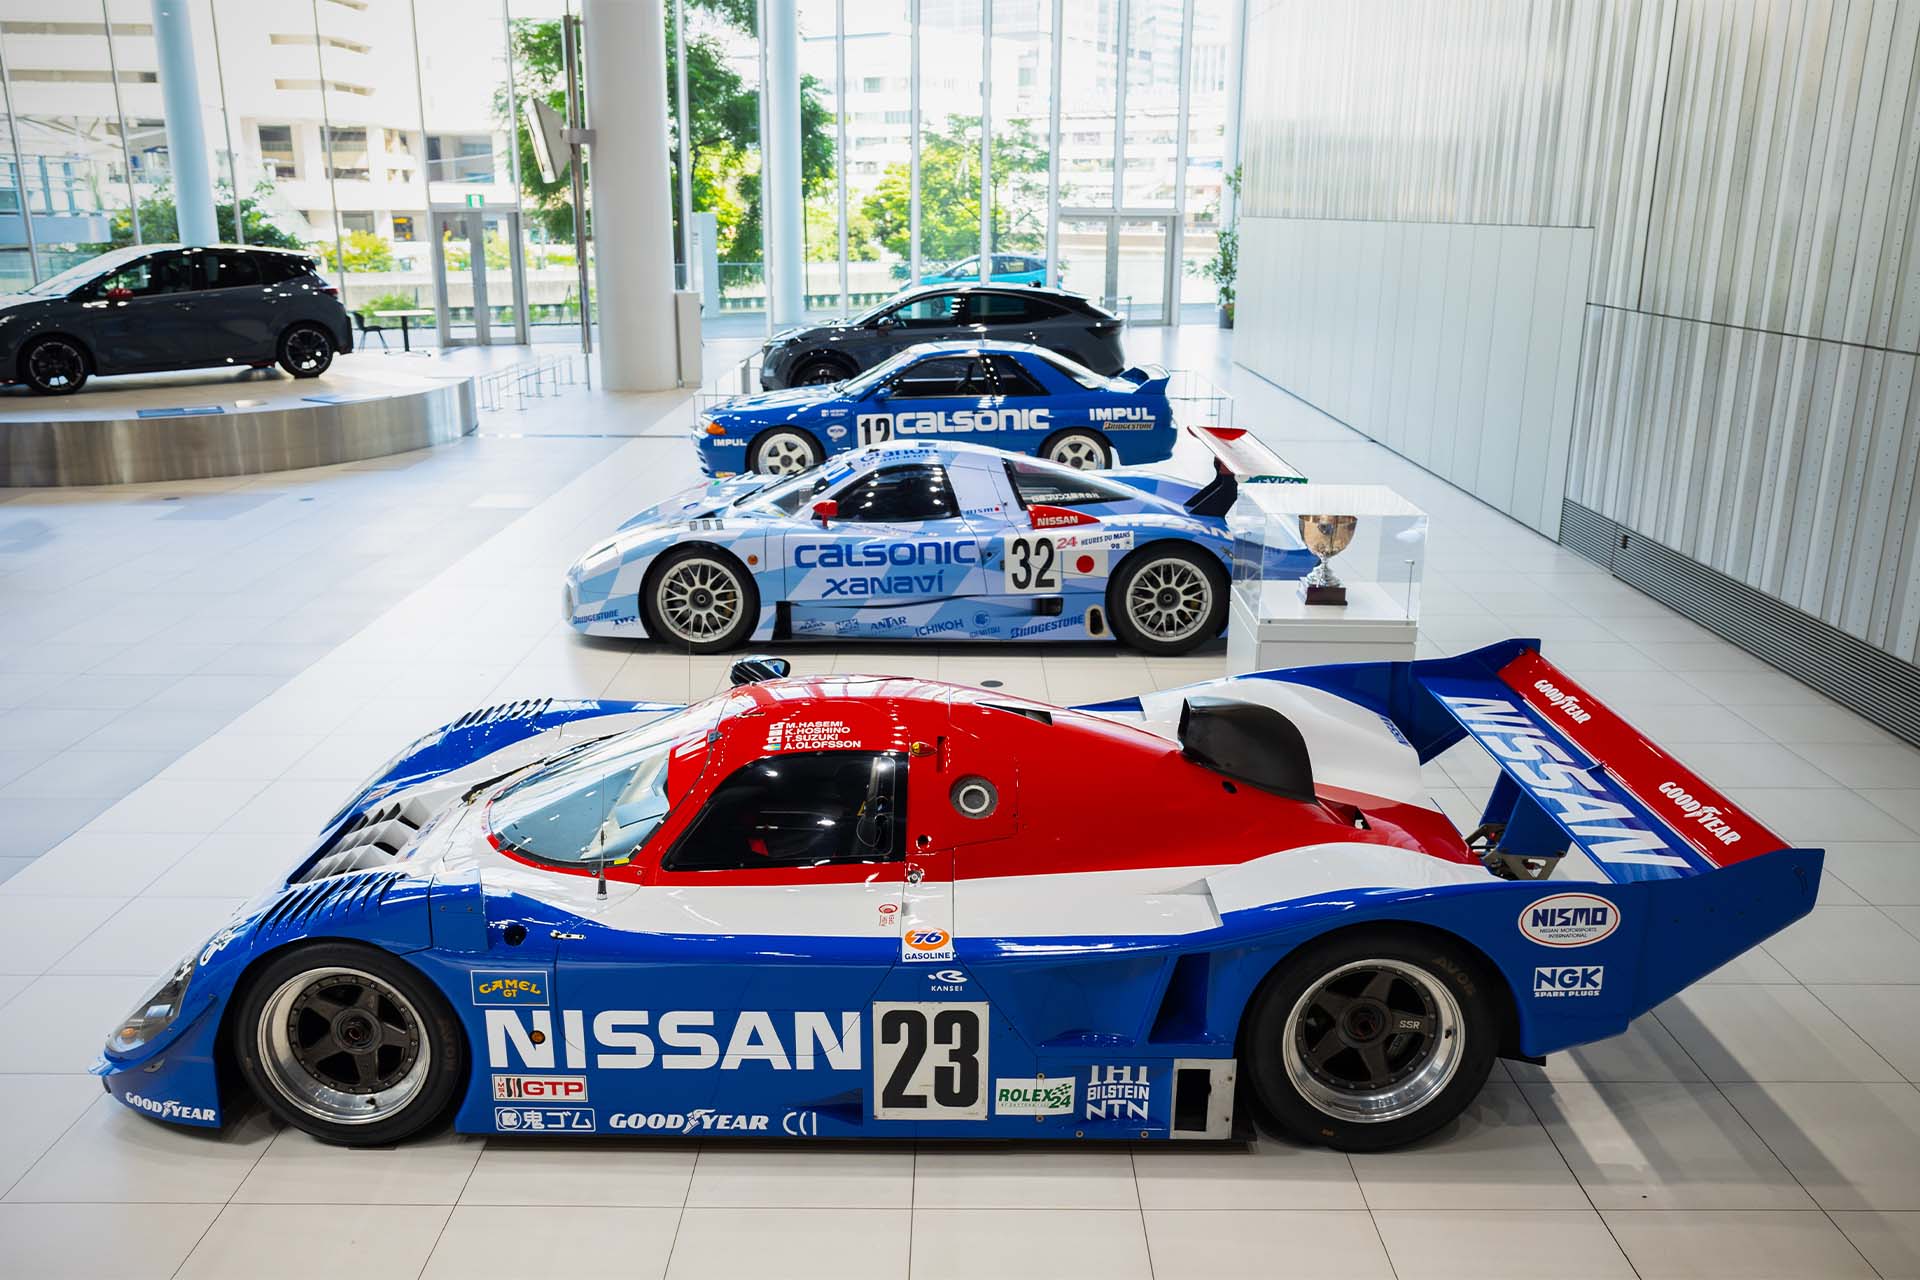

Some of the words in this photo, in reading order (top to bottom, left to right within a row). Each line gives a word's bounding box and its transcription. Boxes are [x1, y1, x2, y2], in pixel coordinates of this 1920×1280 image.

[1089, 408, 1155, 421] IMPUL
[861, 417, 889, 449] 12
[713, 438, 747, 447] IMPUL
[1036, 515, 1078, 526] NISSAN
[1056, 536, 1078, 550] 24
[1080, 536, 1104, 546] HEURES
[1104, 535, 1113, 543] DU
[1113, 531, 1131, 541] MANS
[1011, 537, 1056, 590] 32
[572, 609, 620, 625] BRIDGESTONE
[871, 616, 907, 630] ANTAR
[914, 618, 964, 637] ICHIKOH
[1010, 614, 1085, 638] BRIDGESTONE
[785, 727, 851, 735] K.HOSHINO
[785, 734, 839, 742] T.SUZUKI
[784, 740, 861, 749] A.OLOFSSON
[1441, 695, 1692, 869] NISSAN
[1532, 907, 1608, 927] NISMO
[912, 931, 943, 944] 76
[904, 952, 951, 960] GASOLINE
[1535, 968, 1601, 990] NGK
[479, 979, 542, 996] CAMEL
[503, 988, 518, 998] GT
[1399, 1020, 1421, 1030] SSR
[485, 1009, 862, 1070] NISSAN
[881, 1009, 980, 1109] 23
[523, 1081, 584, 1096] GTP
[1087, 1085, 1149, 1100] BILSTEIN
[998, 1089, 1054, 1102] ROLEX
[1048, 1095, 1071, 1109] 24
[1086, 1100, 1149, 1121] NTN
